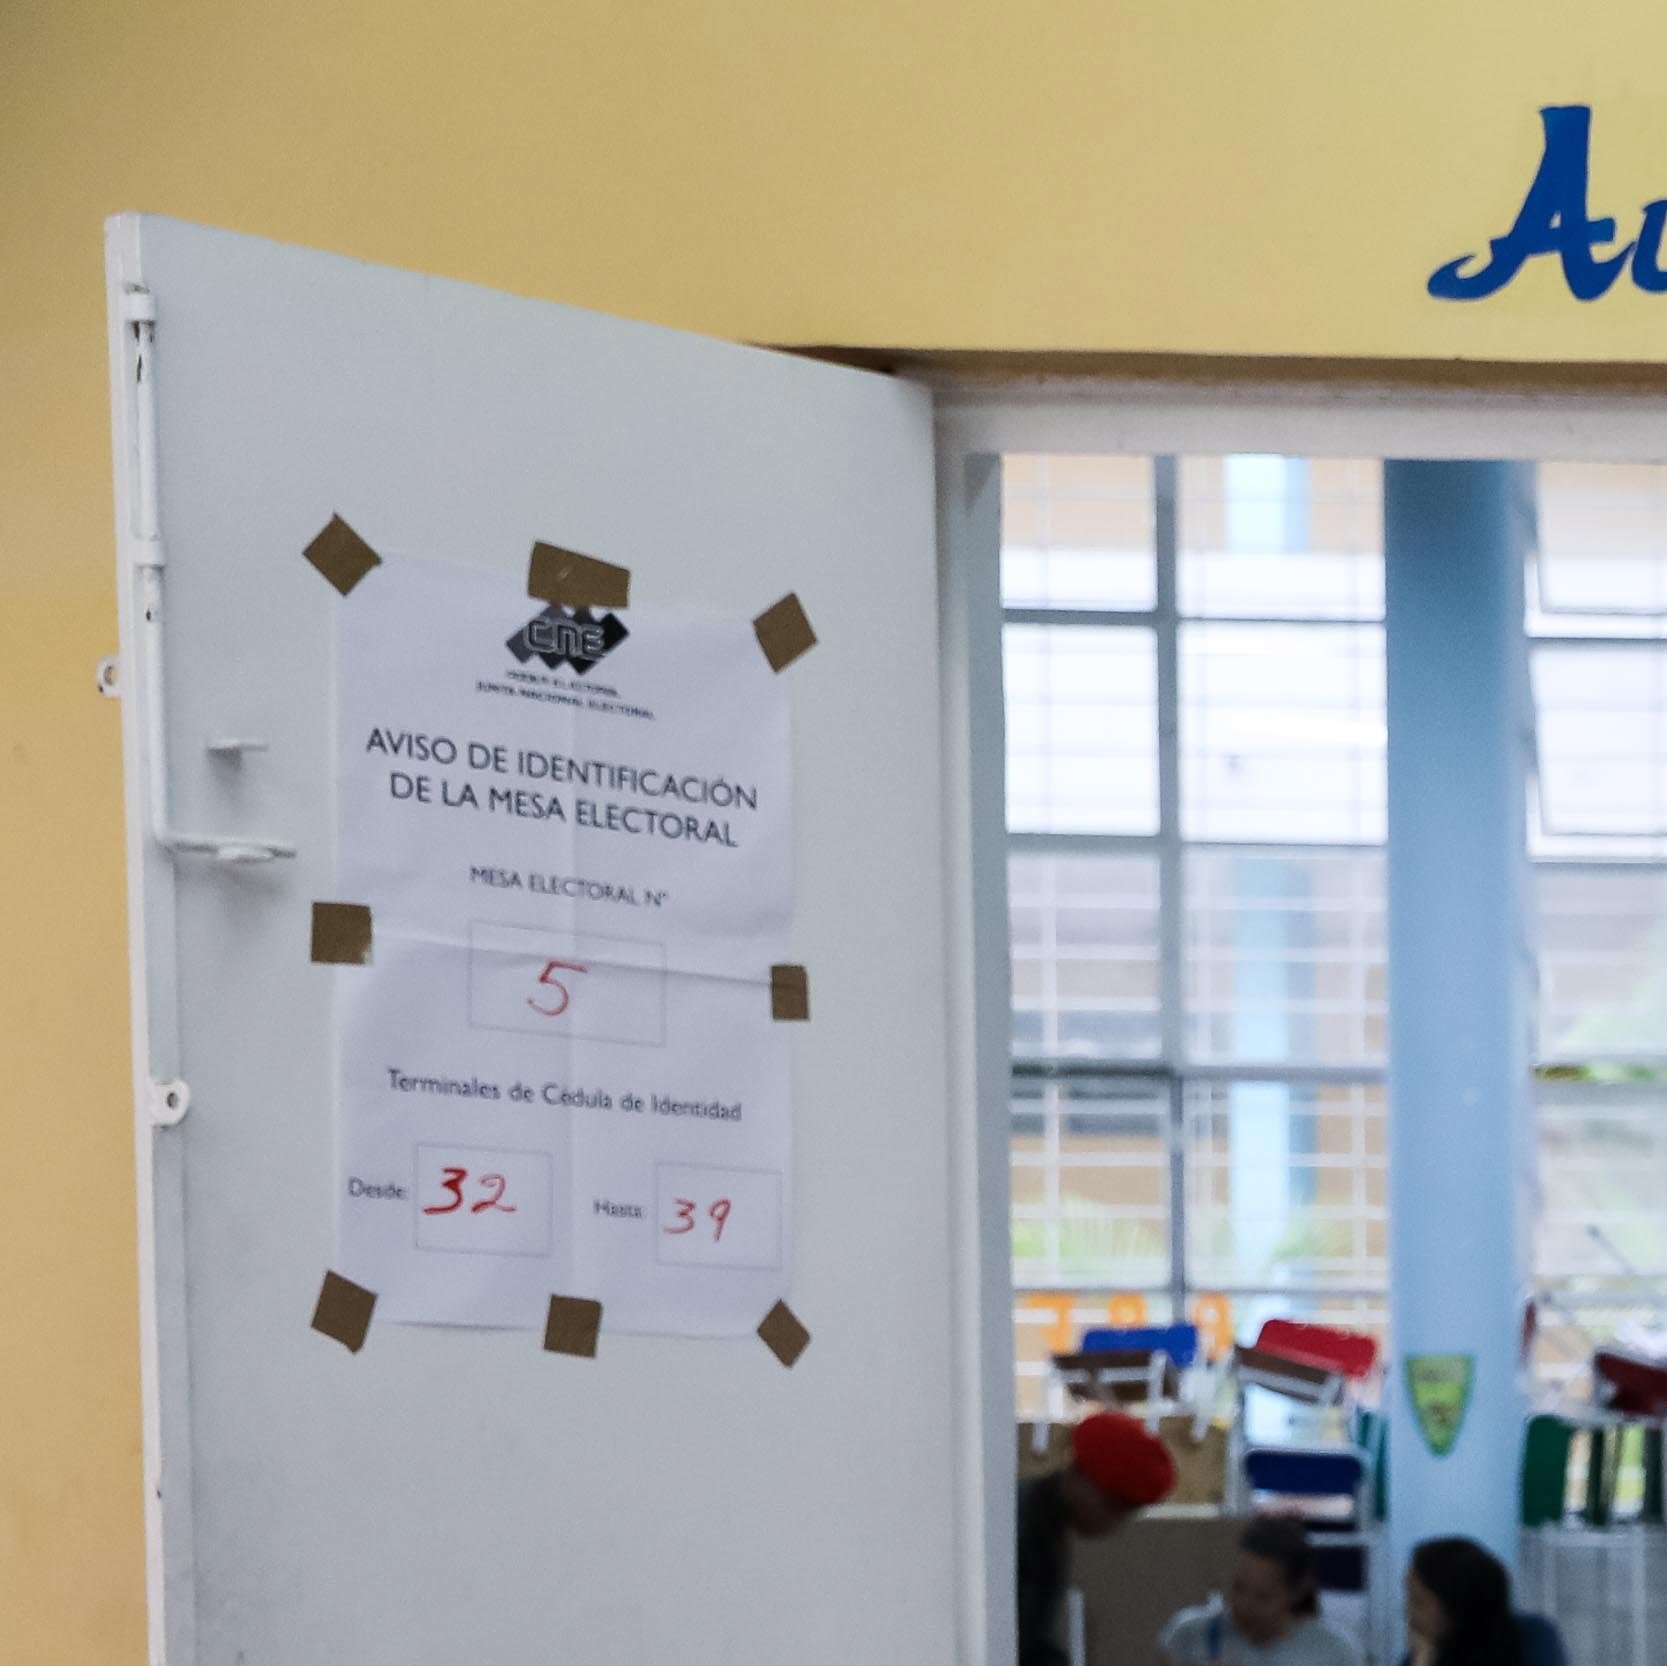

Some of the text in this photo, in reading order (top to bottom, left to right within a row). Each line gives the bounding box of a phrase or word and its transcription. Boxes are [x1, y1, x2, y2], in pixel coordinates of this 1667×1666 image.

[366, 727, 757, 810] AVISO DE IDENTIFICACIÓN
[390, 771, 739, 848] DE LA MESA ELECTORAL
[469, 865, 522, 889] MESA
[528, 872, 640, 907] ELECTORAL
[525, 960, 588, 1016] 5
[387, 1067, 501, 1101] Terminales
[508, 1081, 536, 1104] de
[621, 1092, 645, 1114] de
[650, 1092, 744, 1123] Identidad
[421, 1166, 517, 1215] 32
[662, 1196, 732, 1242] 39
